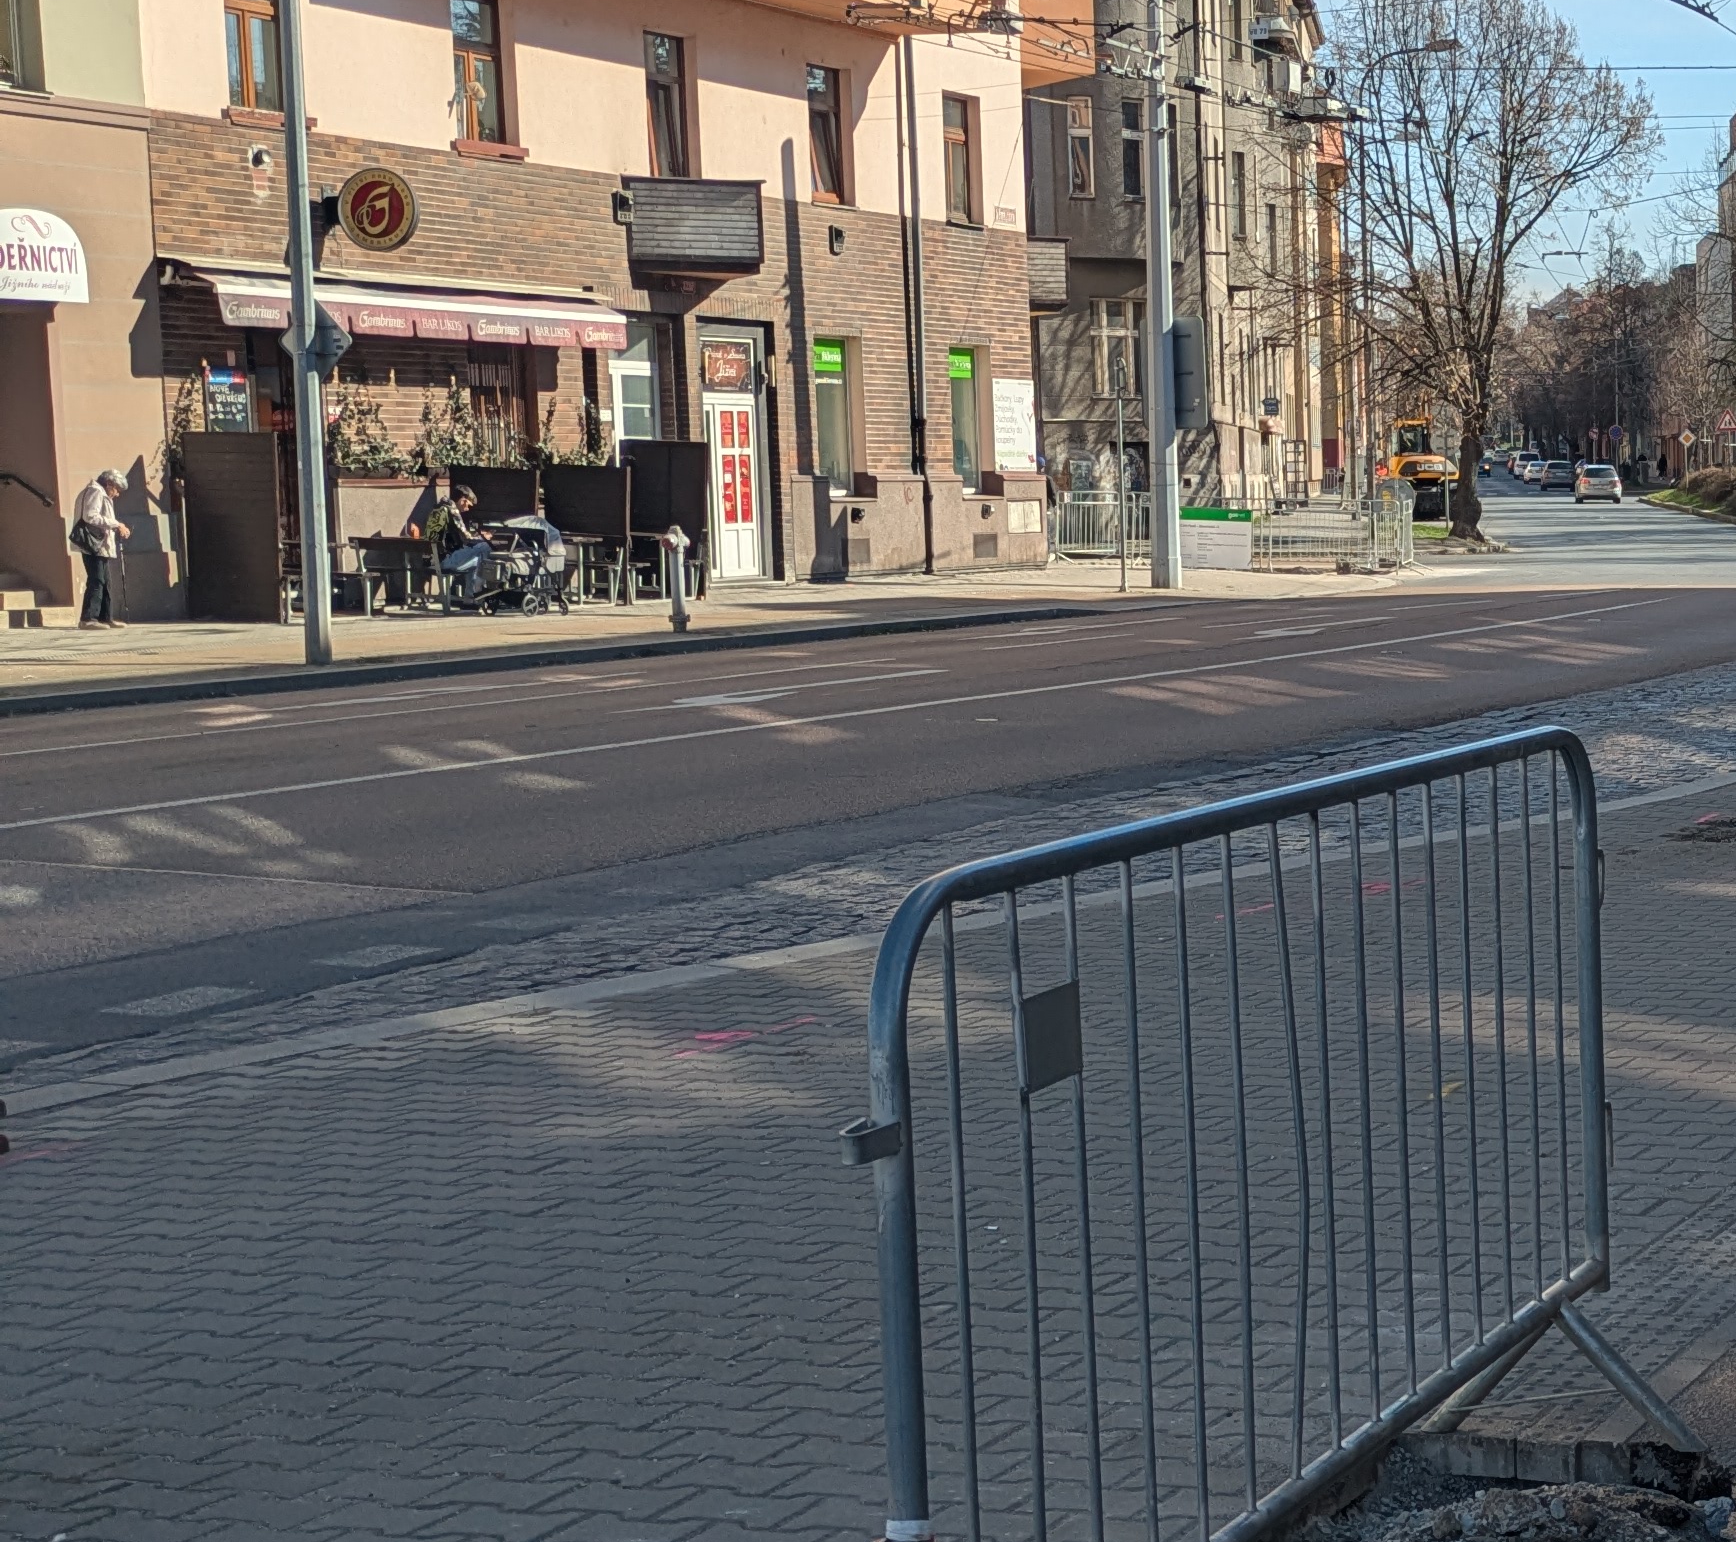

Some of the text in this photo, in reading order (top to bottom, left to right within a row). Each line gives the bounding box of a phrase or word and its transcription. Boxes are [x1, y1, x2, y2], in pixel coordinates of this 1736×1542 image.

[226, 301, 281, 320] Gambrinus
[359, 311, 406, 328] Gambrinus
[422, 317, 438, 330] BAR
[477, 319, 520, 336] Gambrinus
[534, 325, 550, 337] BAR
